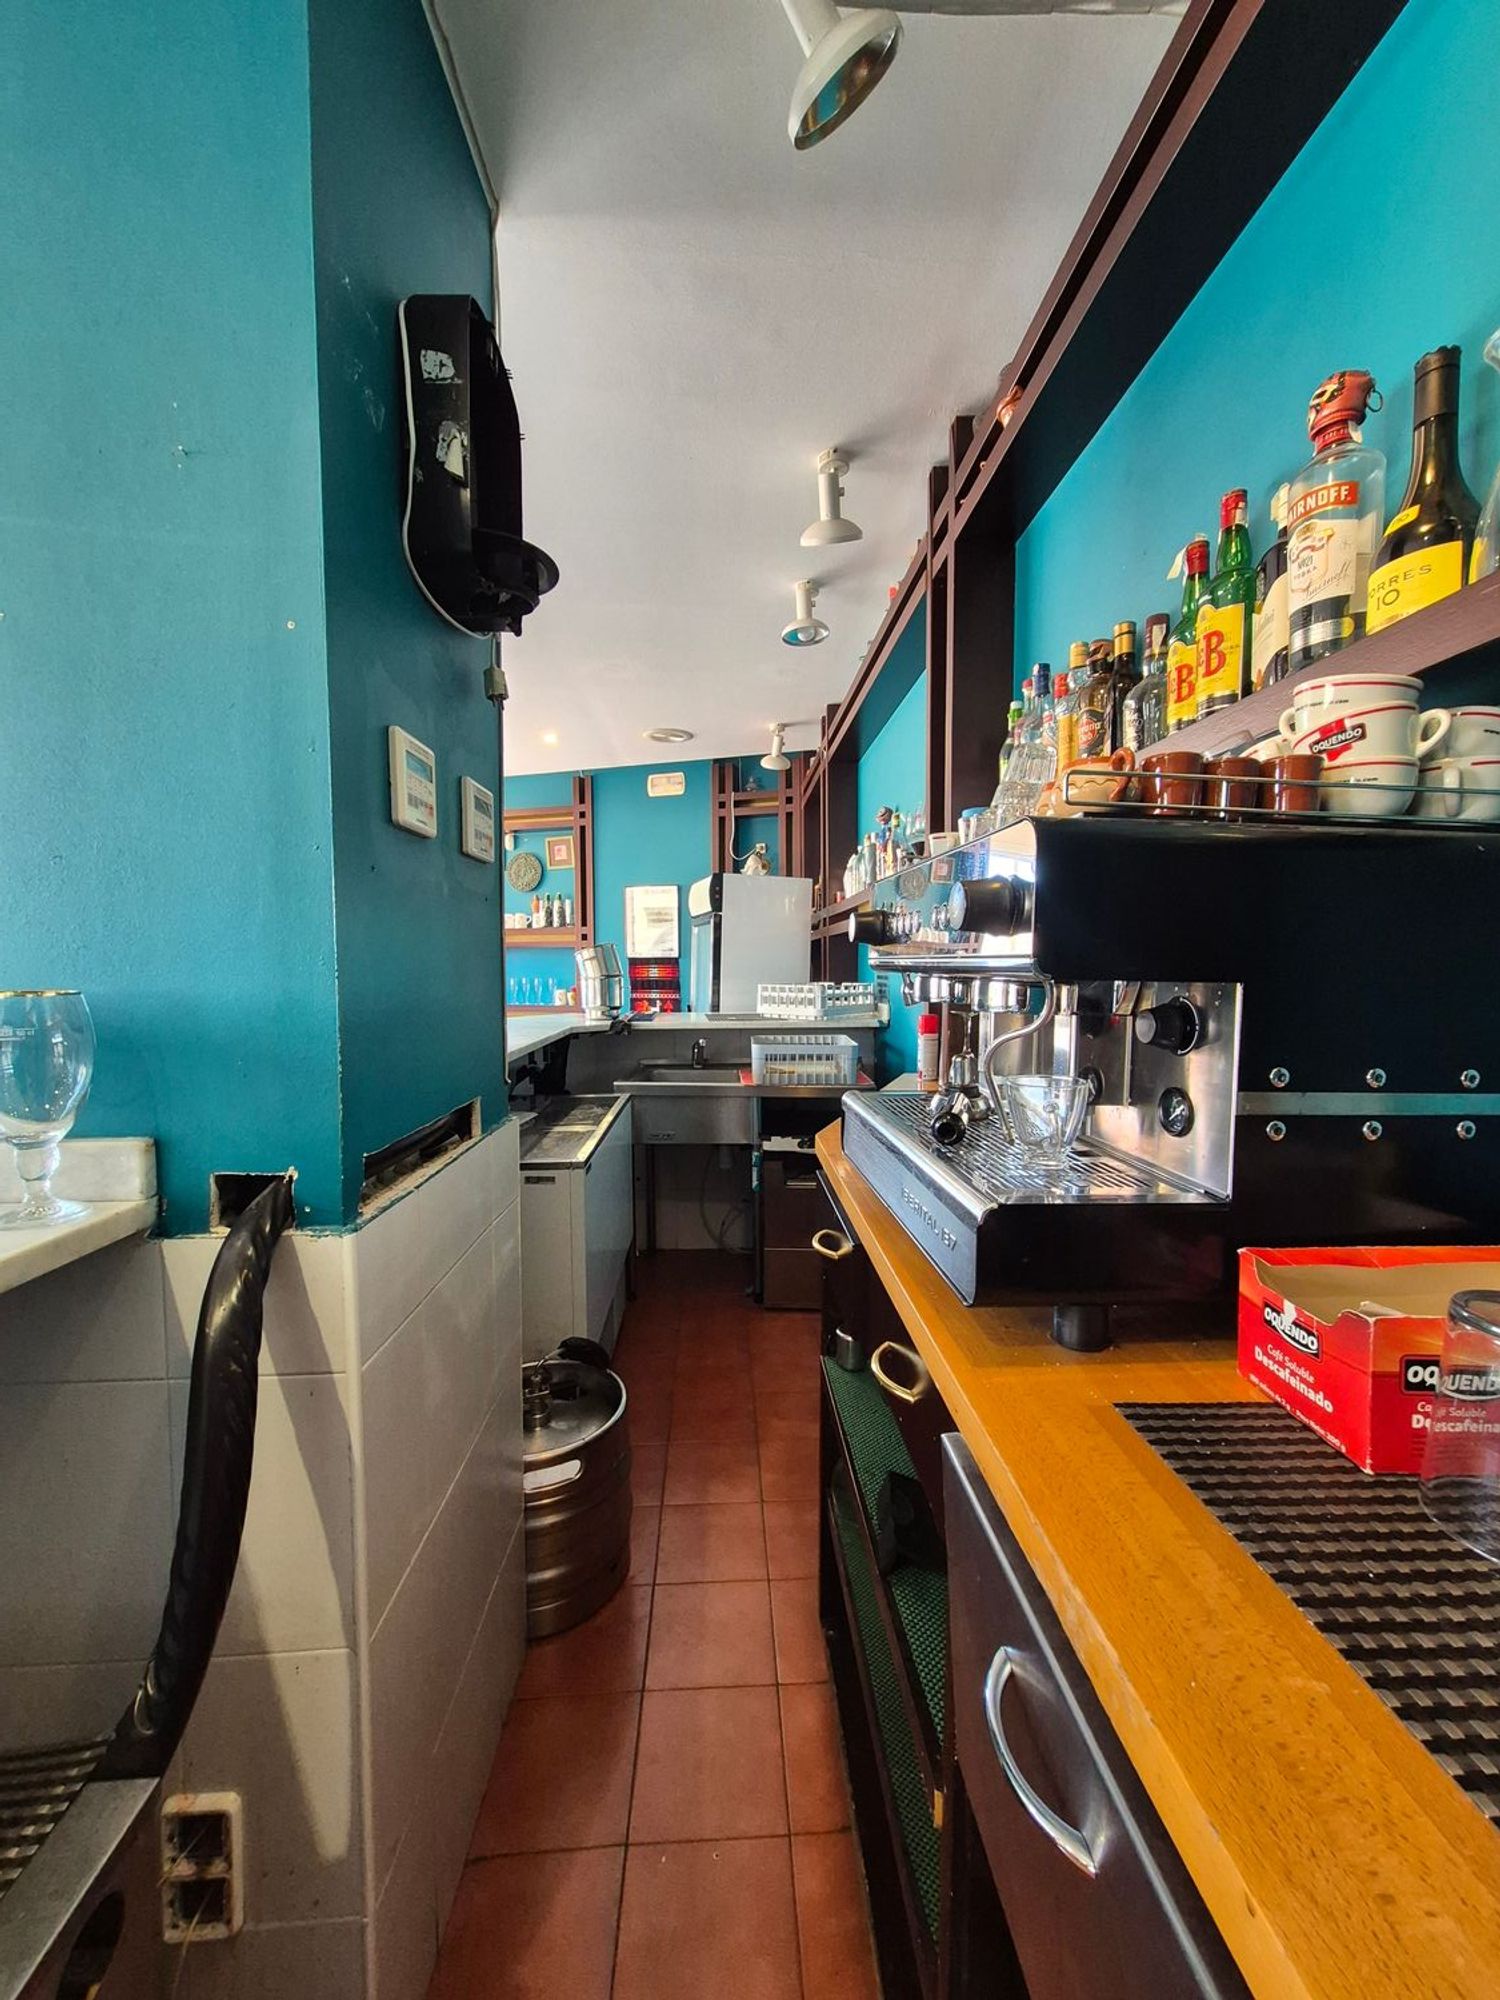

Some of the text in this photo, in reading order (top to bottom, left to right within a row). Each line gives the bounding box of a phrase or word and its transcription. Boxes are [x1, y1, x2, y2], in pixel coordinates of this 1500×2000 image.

[1288, 485, 1350, 521] IRNOFF
[1369, 564, 1432, 599] ORRES
[1376, 588, 1400, 611] 10
[1312, 727, 1363, 753] OQUENDO
[1264, 1306, 1319, 1350] OQUENDO
[1254, 1344, 1334, 1414] Descafeinado
[1285, 1355, 1316, 1384] Soluble
[1406, 1364, 1500, 1392] OQUEND
[1411, 1414, 1500, 1433] Descafeina
